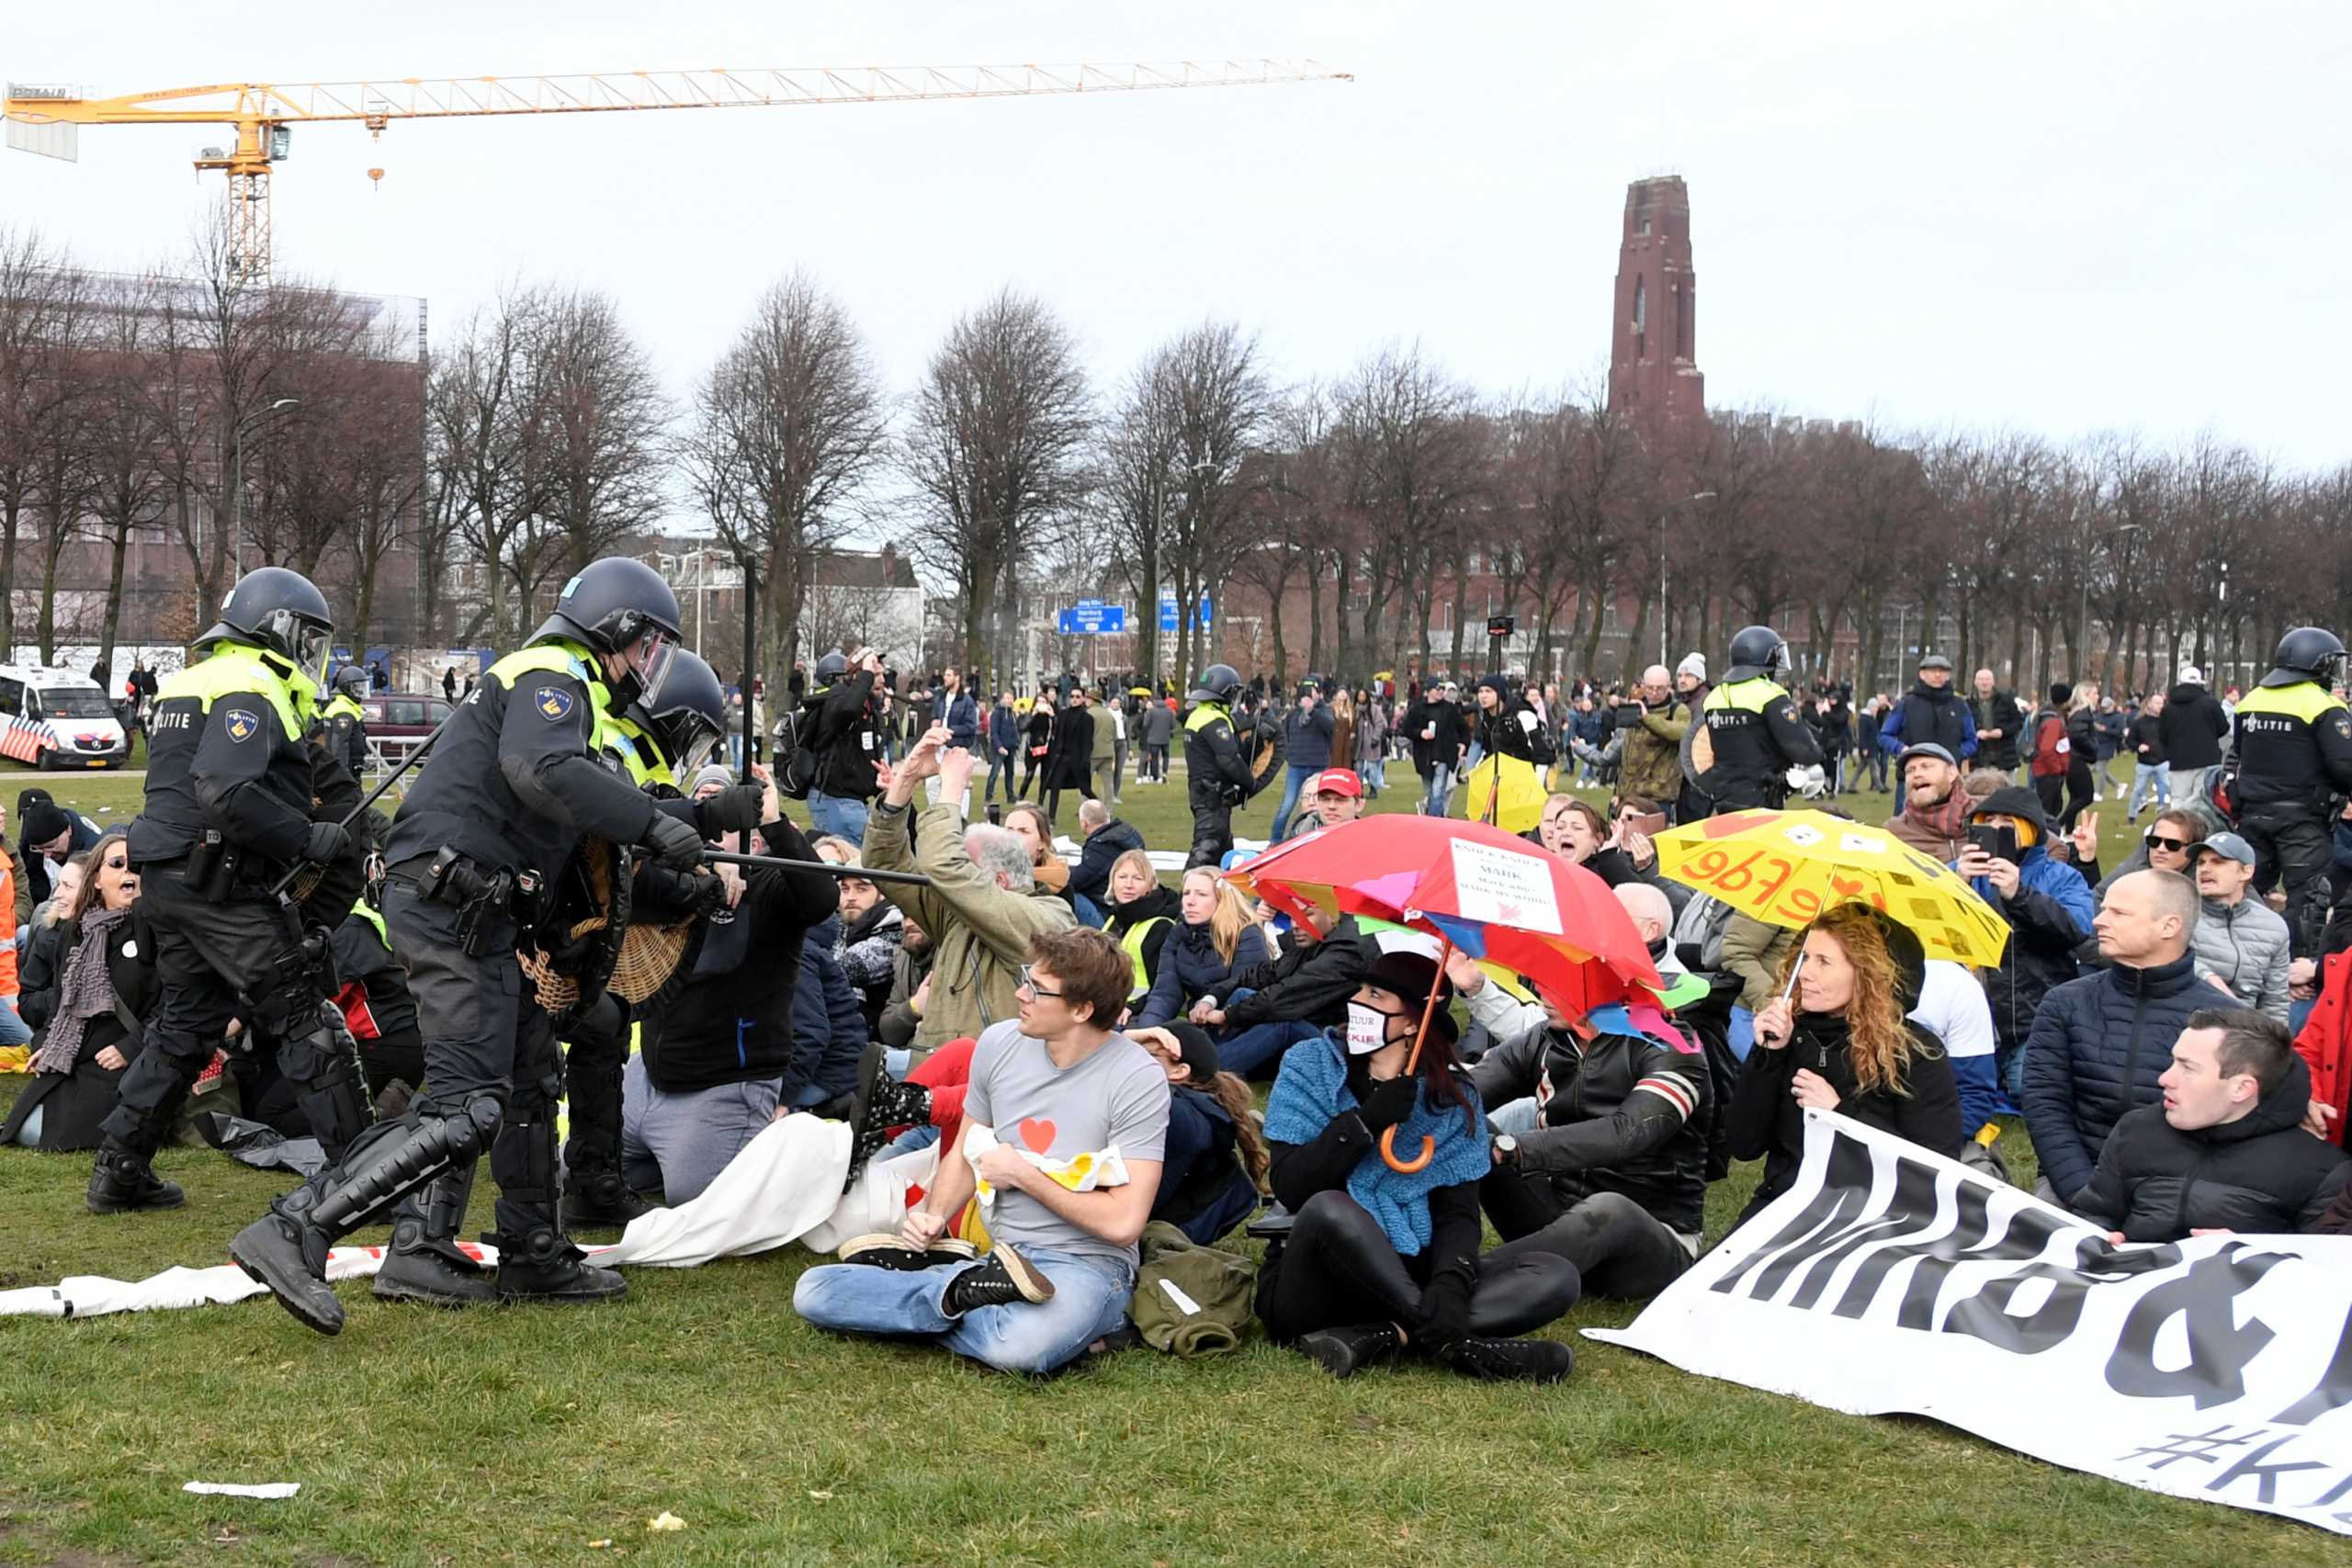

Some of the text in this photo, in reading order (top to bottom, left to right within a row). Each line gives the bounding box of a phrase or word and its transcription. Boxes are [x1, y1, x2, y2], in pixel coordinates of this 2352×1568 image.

[2242, 712, 2292, 733] POLITIE
[2105, 1241, 2302, 1411] &
[2113, 1425, 2352, 1508] #K
